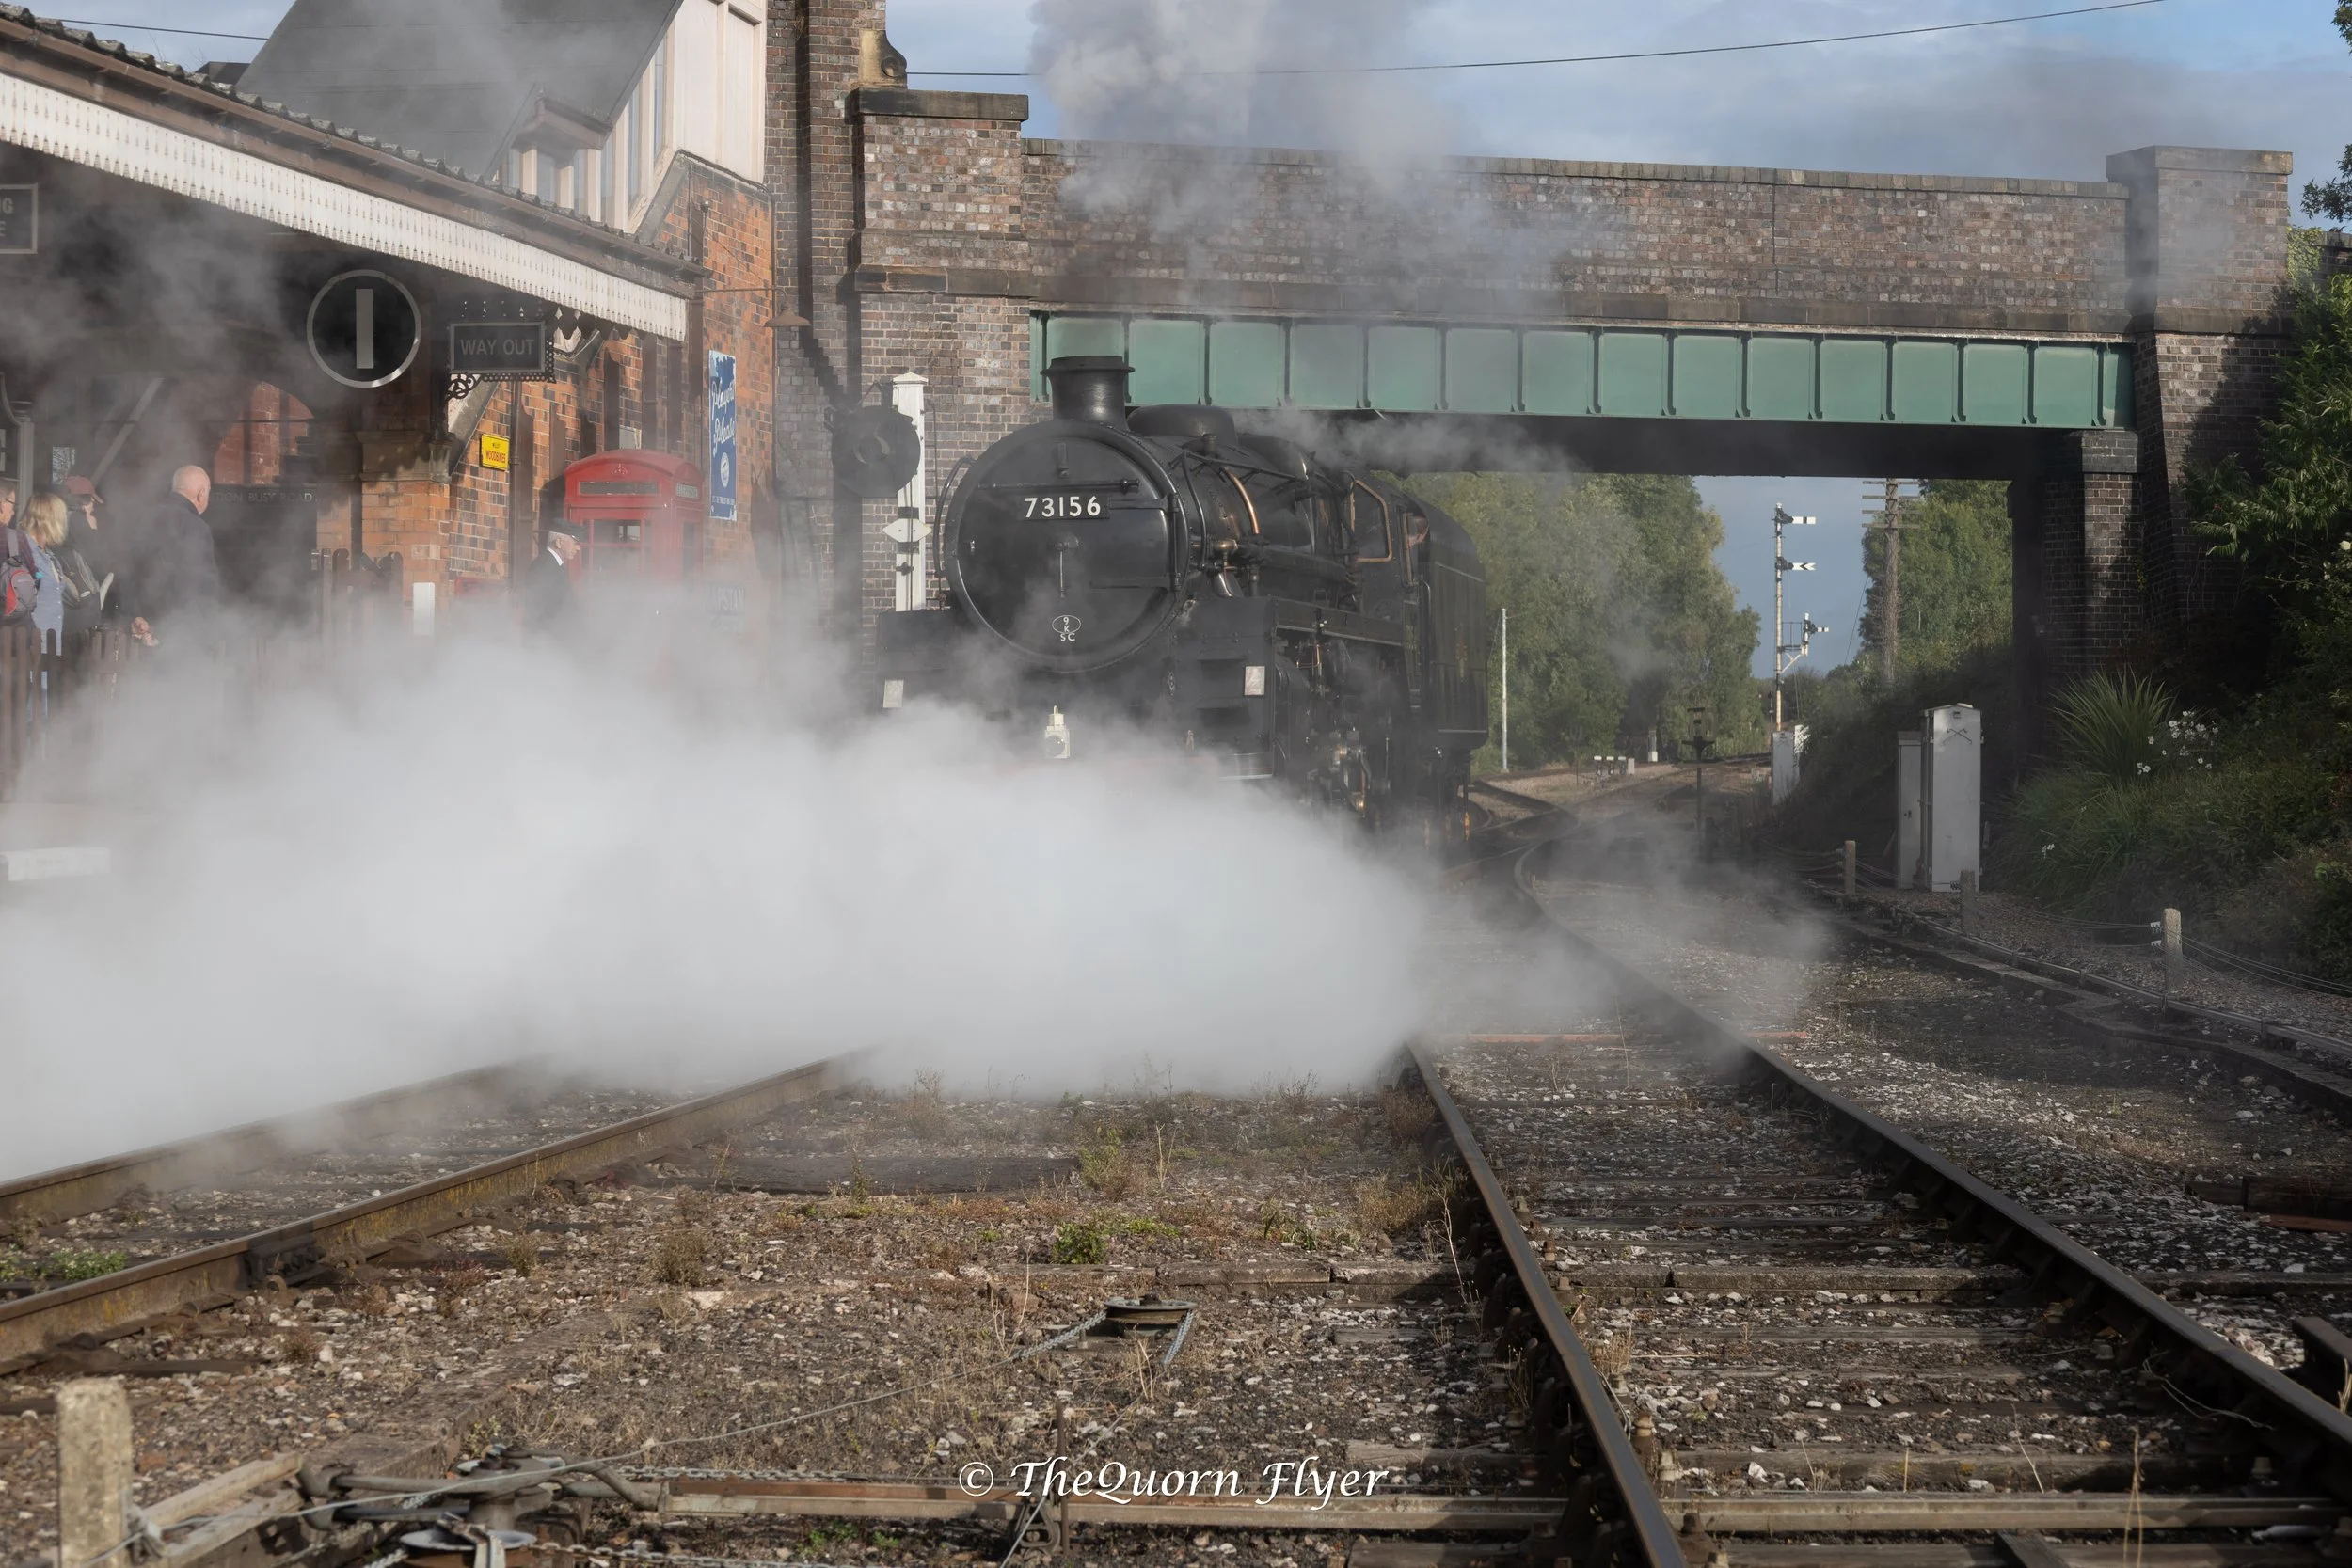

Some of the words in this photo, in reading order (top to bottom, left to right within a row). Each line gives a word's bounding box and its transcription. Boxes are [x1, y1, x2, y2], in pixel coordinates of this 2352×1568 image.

[460, 339, 497, 356] WAY
[502, 339, 534, 356] OUT
[248, 493, 275, 502] BUSY
[1024, 496, 1101, 518] 73156
[1060, 632, 1075, 641] SC
